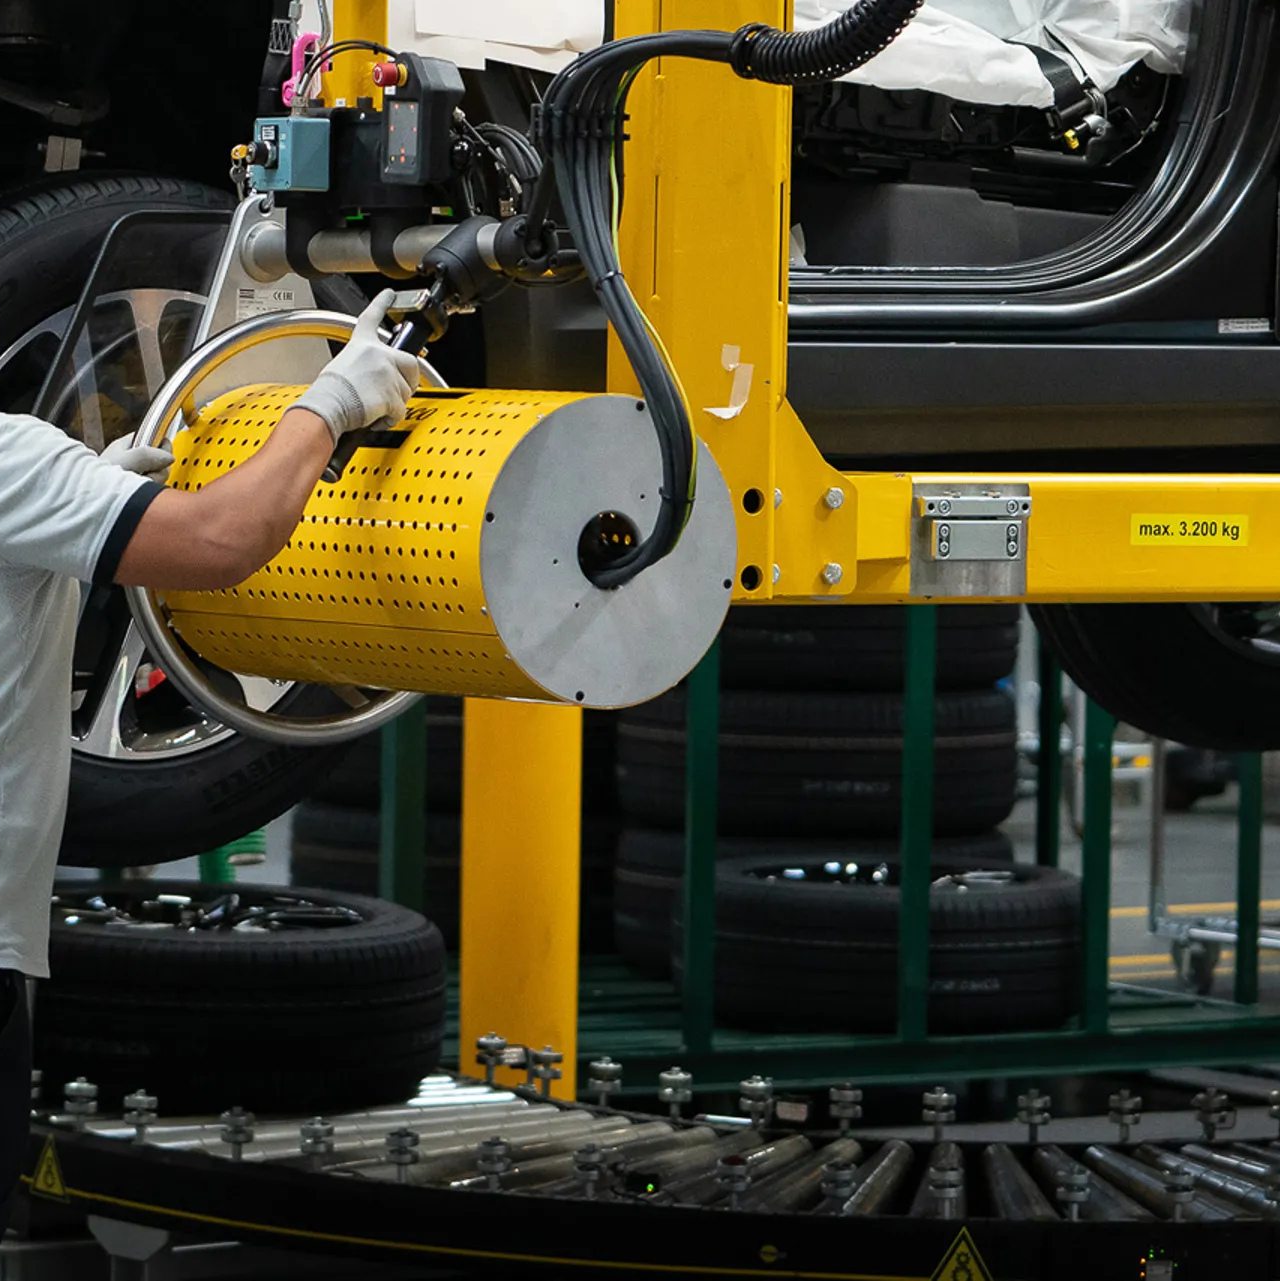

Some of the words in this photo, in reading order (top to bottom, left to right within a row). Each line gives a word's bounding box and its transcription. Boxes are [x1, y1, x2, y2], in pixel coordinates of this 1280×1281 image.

[1139, 523, 1175, 537] max.
[1178, 521, 1218, 537] 3.200
[1221, 521, 1240, 541] kg
